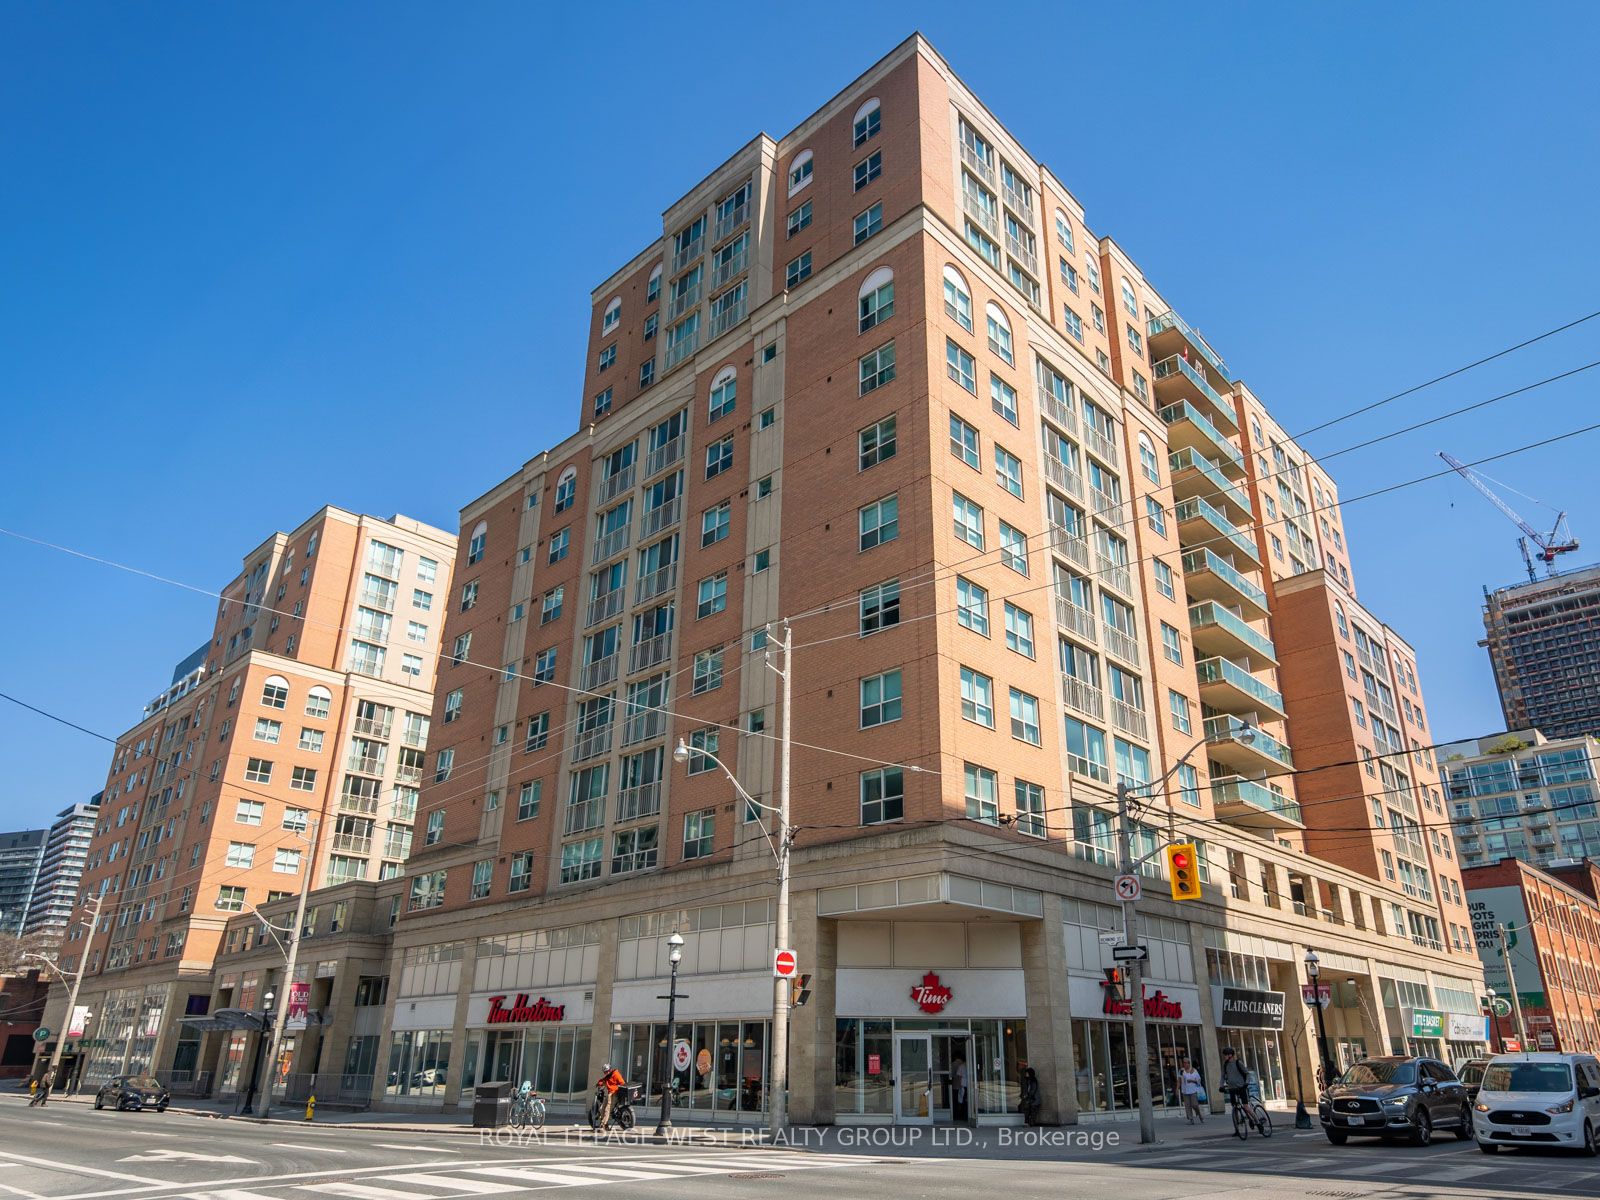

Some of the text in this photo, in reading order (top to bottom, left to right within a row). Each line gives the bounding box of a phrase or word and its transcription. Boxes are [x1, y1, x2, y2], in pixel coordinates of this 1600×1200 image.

[1474, 930, 1500, 940] PRIS
[1476, 940, 1494, 949] OU
[915, 986, 948, 1005] Tims
[1141, 983, 1183, 1020] ortons
[487, 993, 566, 1024] Tim Hortons
[1223, 998, 1283, 1016] PLATIS CLEANERS
